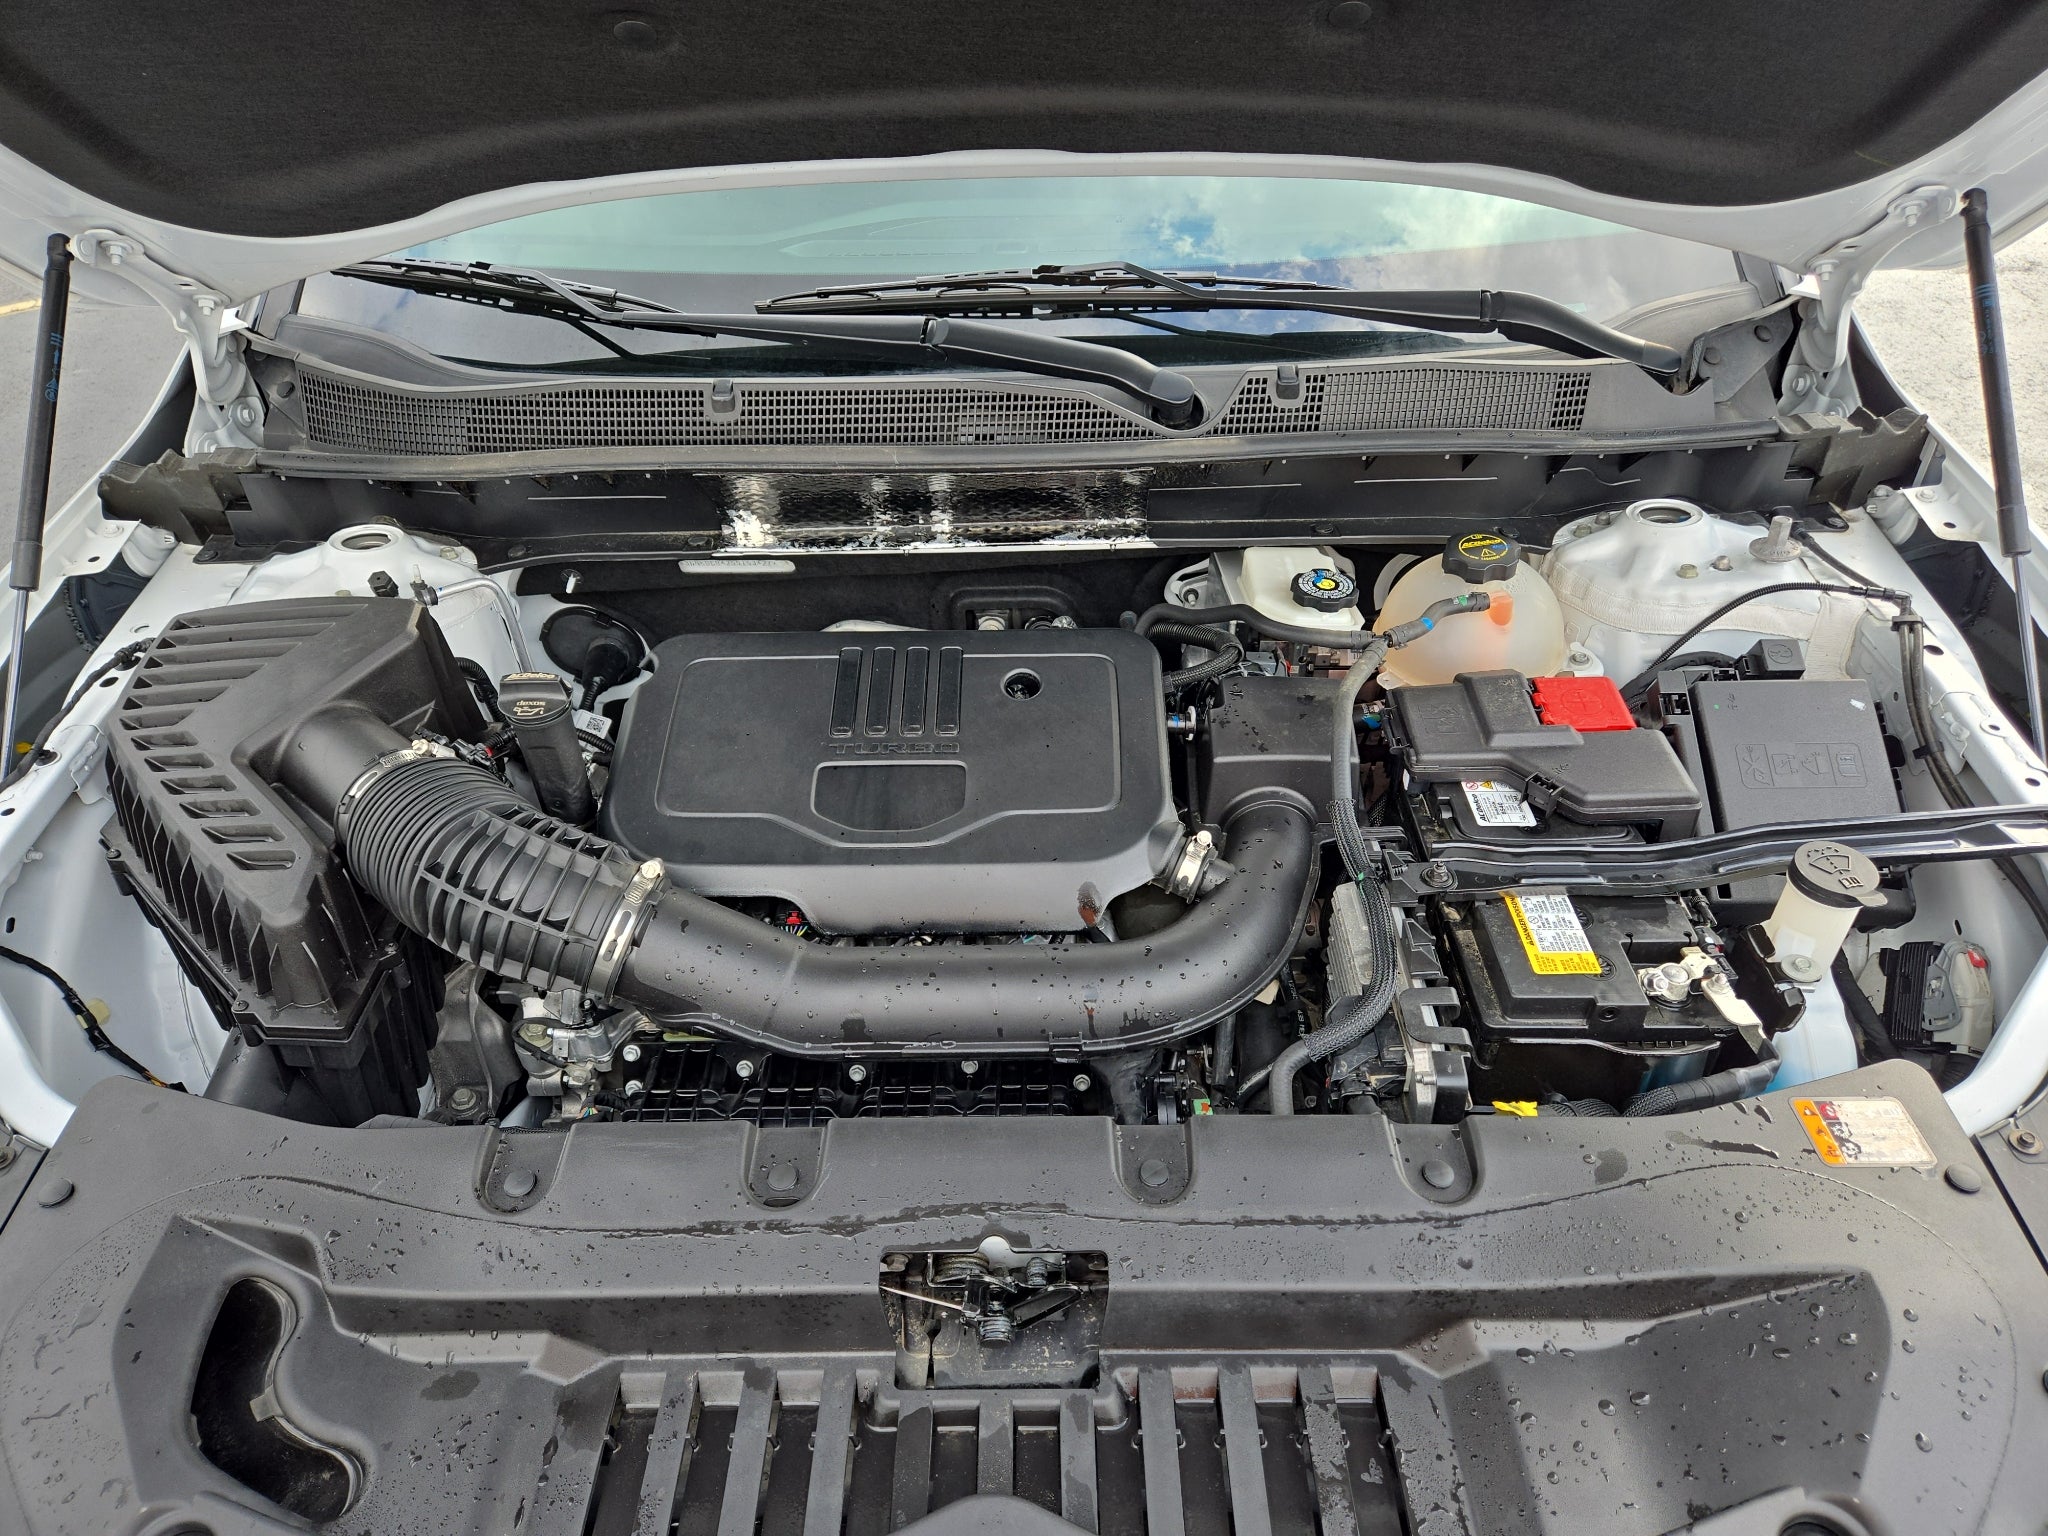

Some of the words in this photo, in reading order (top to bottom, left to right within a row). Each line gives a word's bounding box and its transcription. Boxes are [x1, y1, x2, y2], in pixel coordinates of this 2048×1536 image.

[503, 672, 556, 681] ACDelco
[828, 743, 960, 755] TURBO
[1471, 793, 1488, 823] ACDelco
[1519, 918, 1533, 940] DANGER
